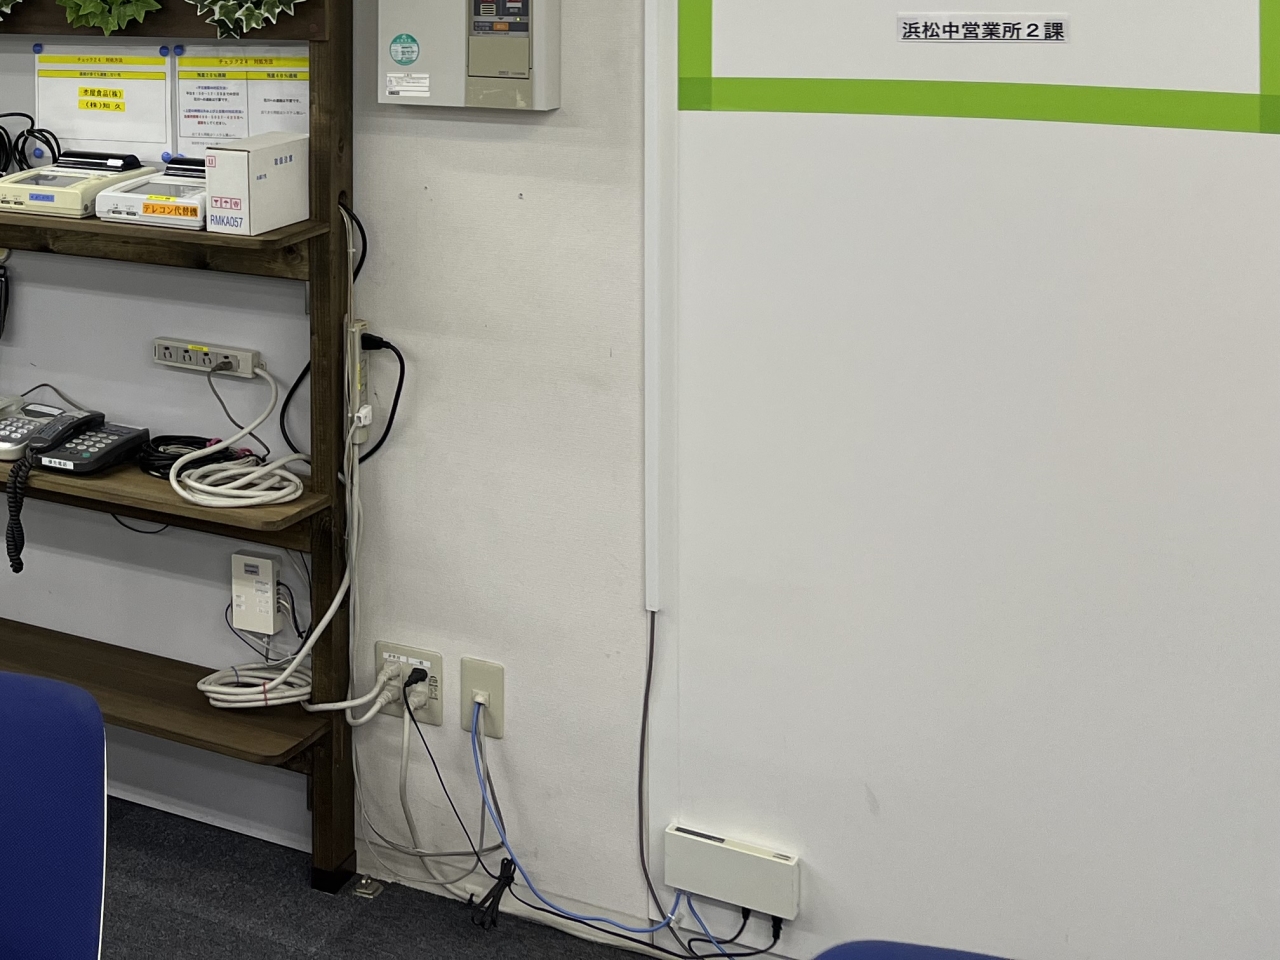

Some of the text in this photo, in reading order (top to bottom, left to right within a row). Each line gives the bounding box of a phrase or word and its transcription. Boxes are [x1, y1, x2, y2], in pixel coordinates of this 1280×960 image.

[902, 21, 1065, 40] 浜松中営業所2課
[143, 204, 198, 218] テレコン代替機
[210, 214, 244, 229] RMKA057
